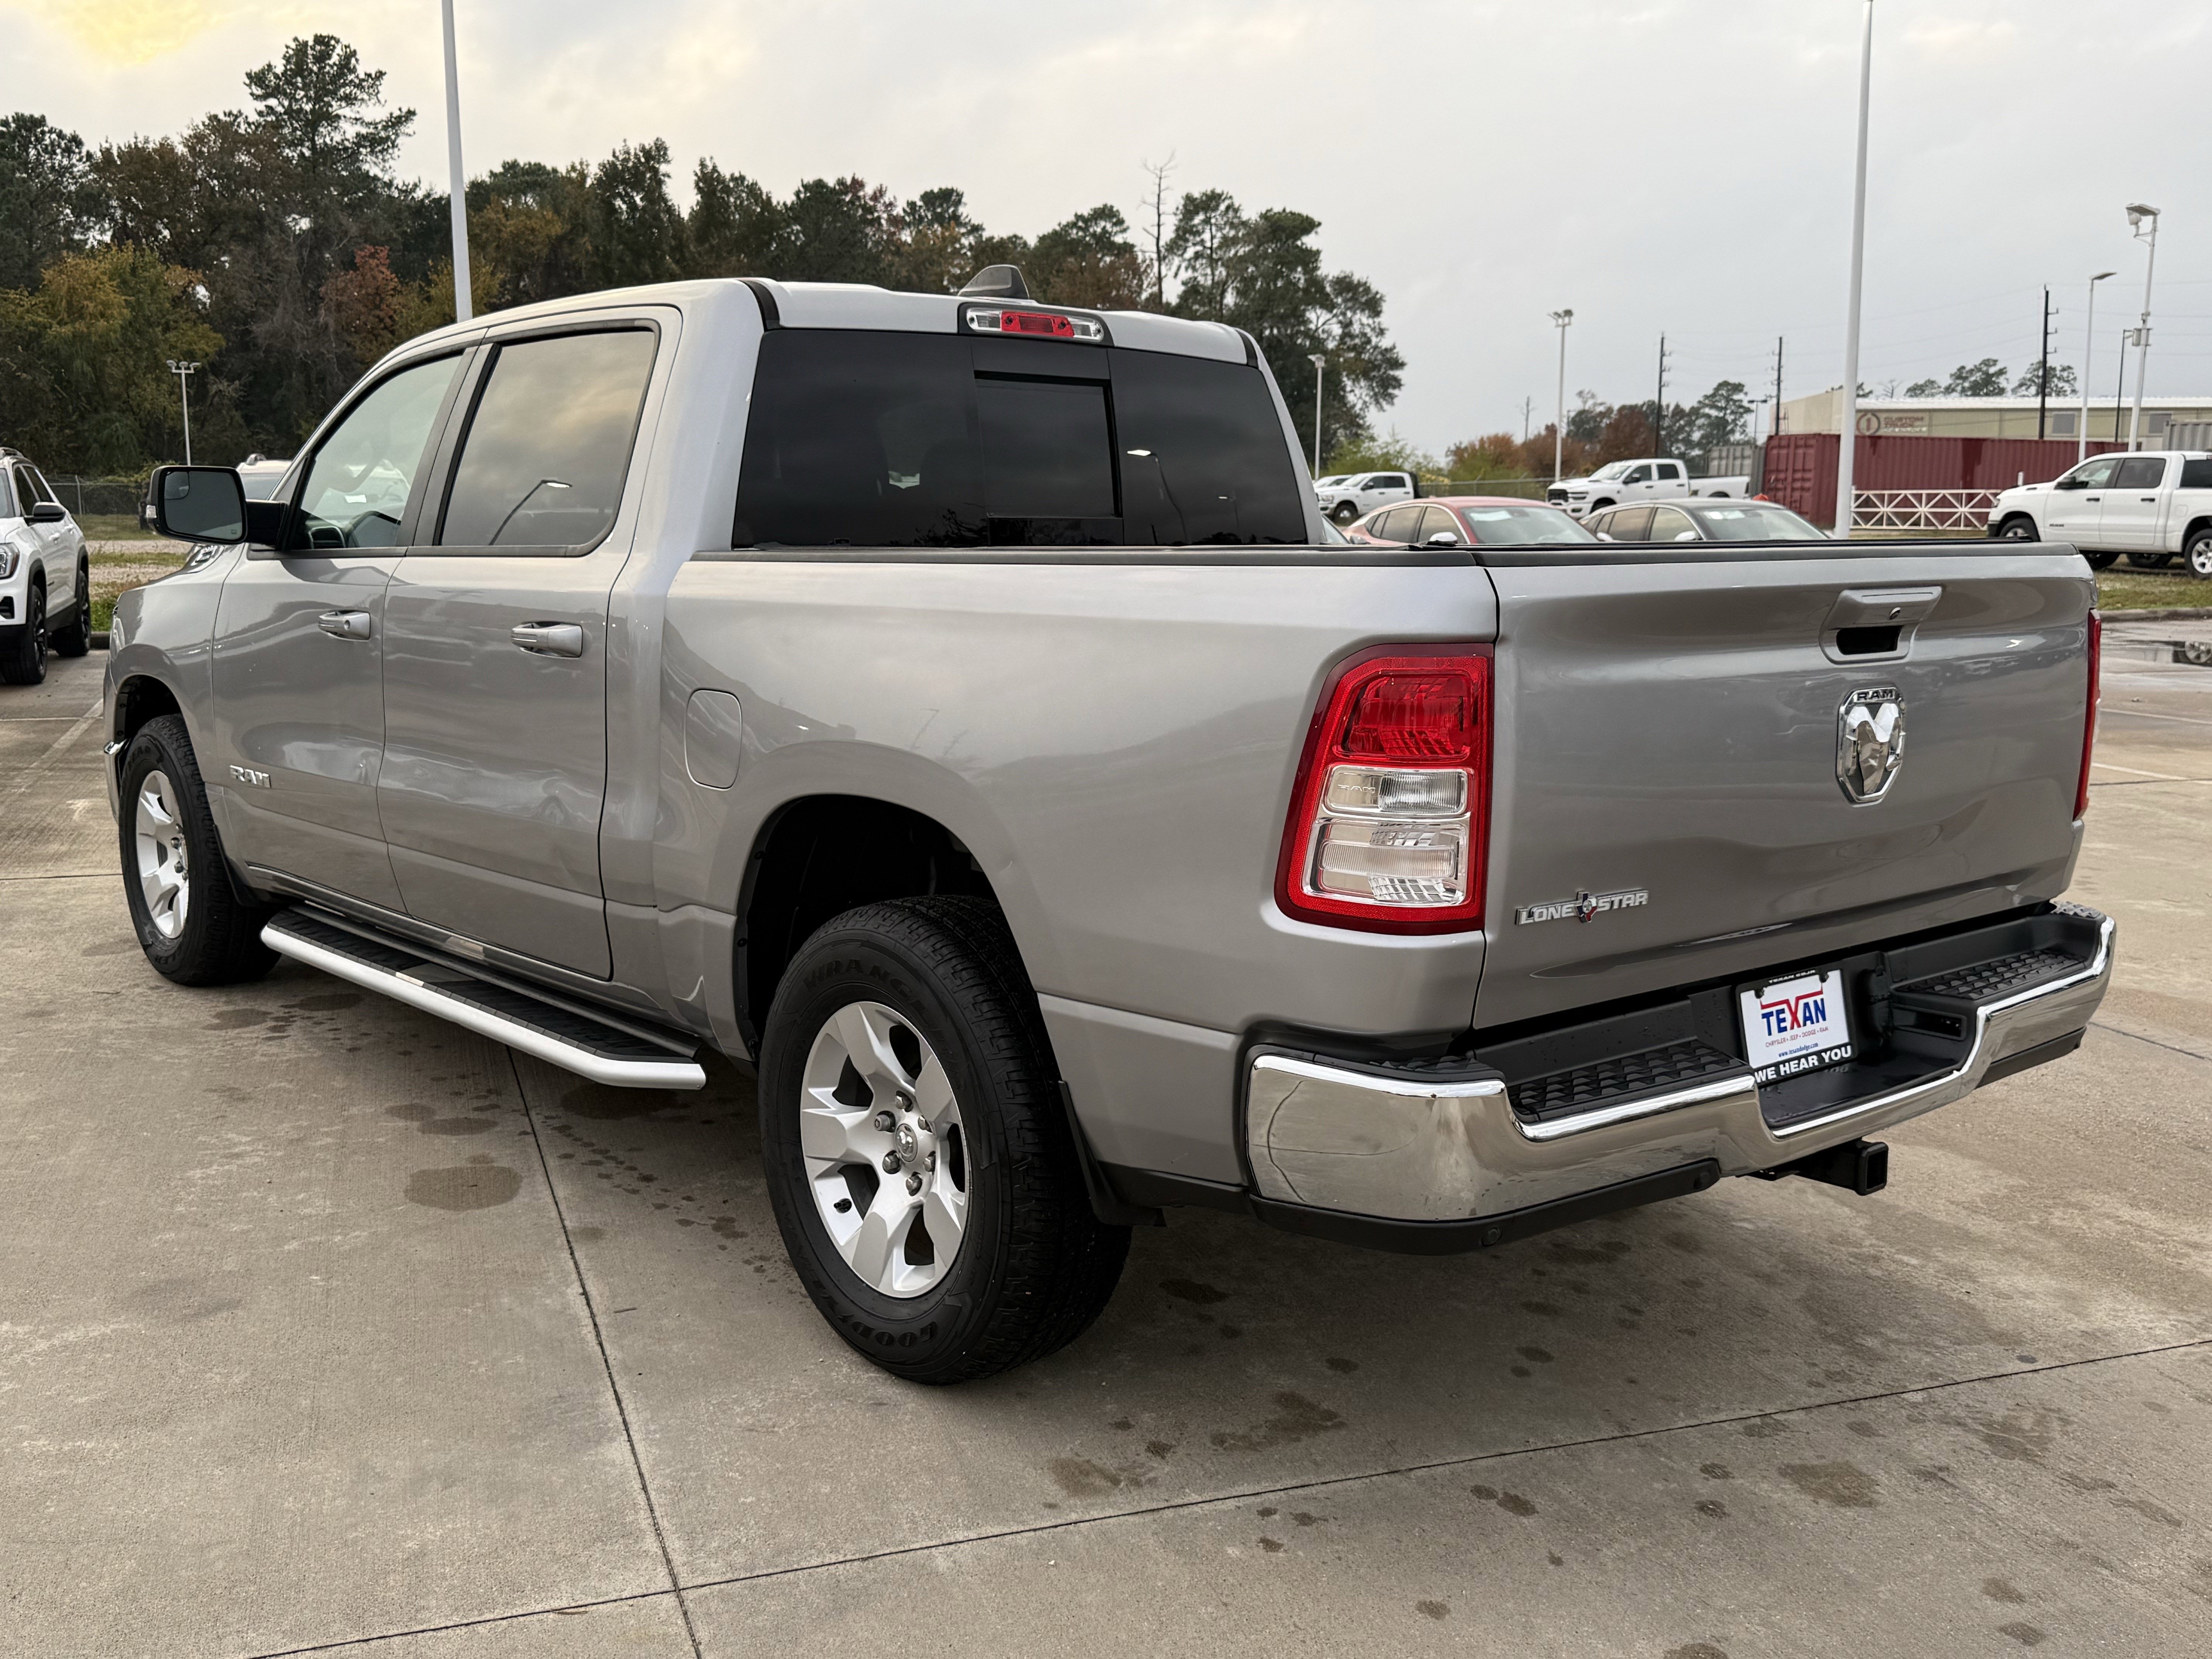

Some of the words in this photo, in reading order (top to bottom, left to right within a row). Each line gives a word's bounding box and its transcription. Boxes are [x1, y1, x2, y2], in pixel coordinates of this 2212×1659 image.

[1857, 690, 1893, 701] RAM
[230, 765, 271, 788] RAM
[1337, 784, 1376, 794] RAM
[1516, 902, 1577, 925] LONE
[1596, 890, 1649, 912] STAR
[1768, 974, 1794, 984] TEXAN
[1761, 995, 1827, 1036] TEXAN
[1765, 1037, 1786, 1048] CHRYSLER
[1802, 1029, 1816, 1037] DODGE
[1755, 1066, 1776, 1083] WE
[1779, 1055, 1819, 1076] HEAR
[1821, 1045, 1851, 1063] YOU
